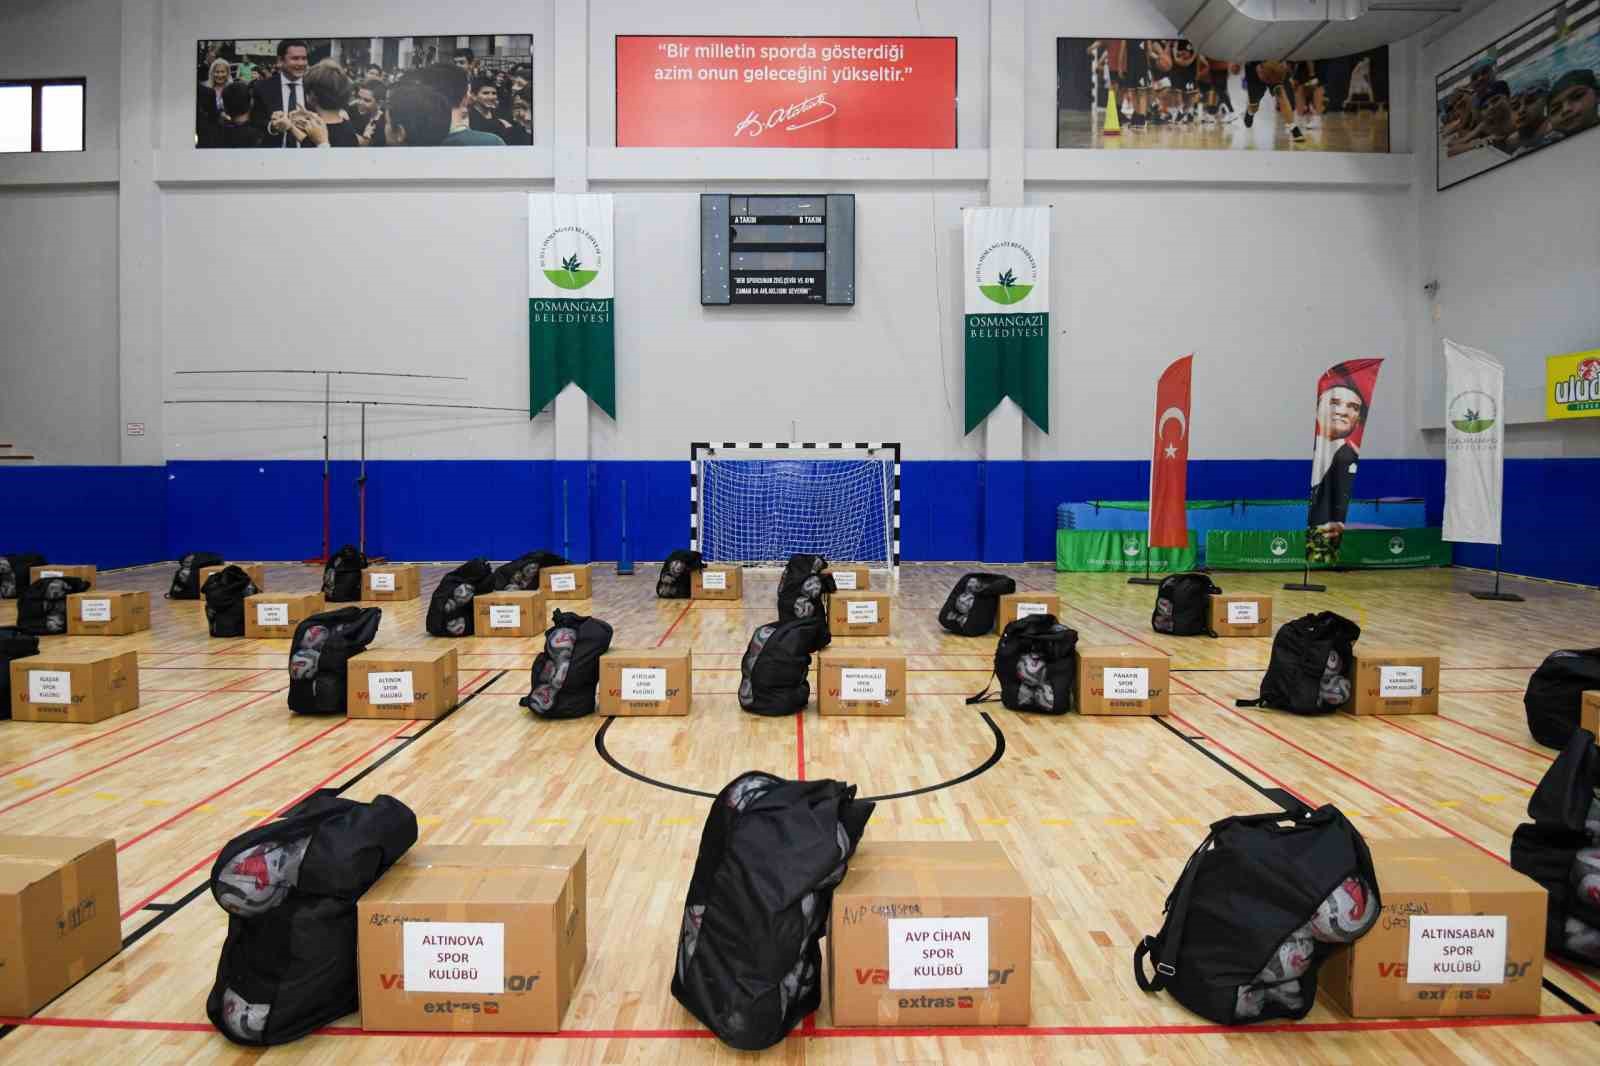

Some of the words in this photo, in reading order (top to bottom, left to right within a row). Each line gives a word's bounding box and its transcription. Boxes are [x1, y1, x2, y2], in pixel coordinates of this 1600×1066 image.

[695, 43, 756, 59] milletin
[761, 43, 817, 63] sporda
[822, 43, 905, 63] gösterdiği
[654, 66, 692, 82] azim
[698, 69, 739, 82] onun
[743, 66, 828, 84] geleceğini
[534, 301, 609, 313] OSMANGAZİ
[534, 313, 609, 323] BELEDİYESİ
[969, 315, 1043, 327] OSMANGAZİ
[970, 327, 1043, 338] BELEDİYESİ
[905, 930, 929, 943] AVP
[933, 927, 971, 942] CİHAN
[1421, 928, 1495, 940] ALTINSABAN
[422, 935, 485, 947] ALTINOVA
[922, 947, 955, 959] SPOR
[1443, 945, 1473, 957] SPOR
[437, 952, 470, 964] SPOR
[914, 963, 963, 977] KULÜBÜ
[1433, 959, 1481, 974] KULÜBÜ
[428, 968, 479, 981] KULÜBÜ
[898, 995, 955, 1009] extras
